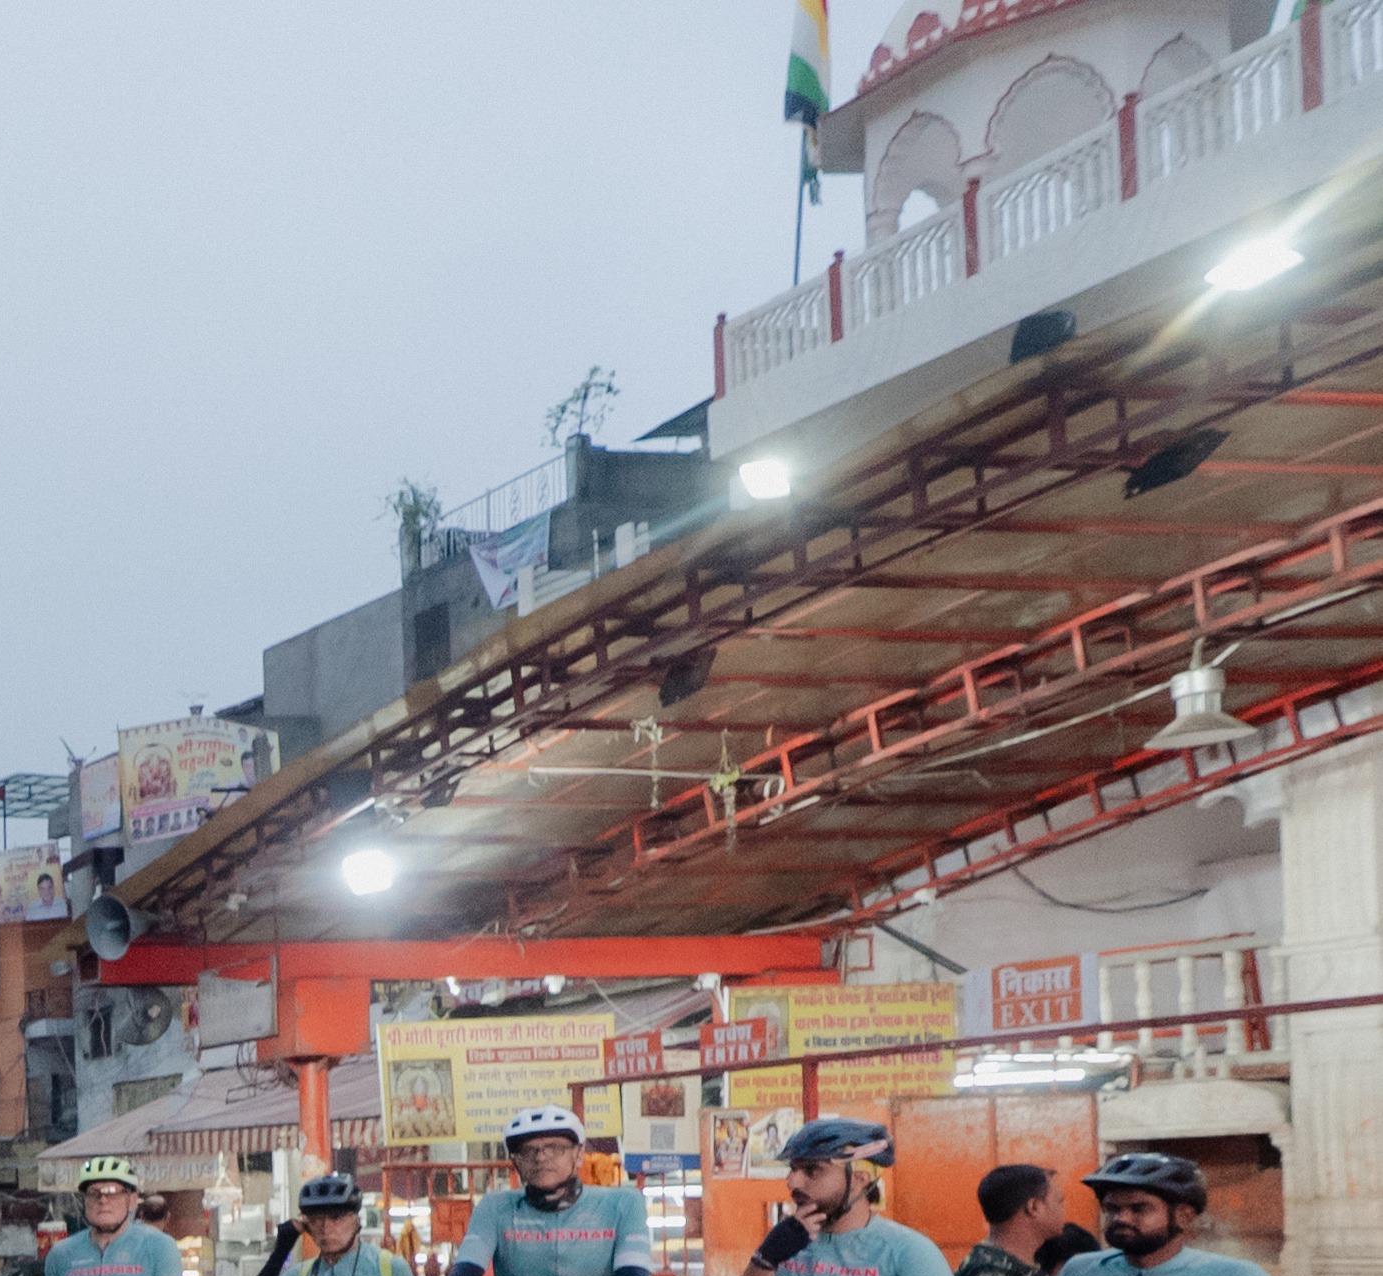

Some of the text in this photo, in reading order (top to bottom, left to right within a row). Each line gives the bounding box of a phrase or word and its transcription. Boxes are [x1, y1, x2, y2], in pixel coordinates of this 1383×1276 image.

[998, 965, 1073, 998] निकास
[1000, 998, 1073, 1028] EXIT
[387, 1028, 401, 1046] श्री
[405, 1026, 433, 1045] मोती
[470, 1023, 504, 1042] गणेश
[508, 1021, 523, 1041] जी
[559, 1020, 576, 1040] की
[581, 1021, 607, 1039] पहल
[704, 1042, 762, 1064] ENTRY
[608, 1055, 658, 1076] ENTRY
[503, 1228, 616, 1242] CYCLESTHAN
